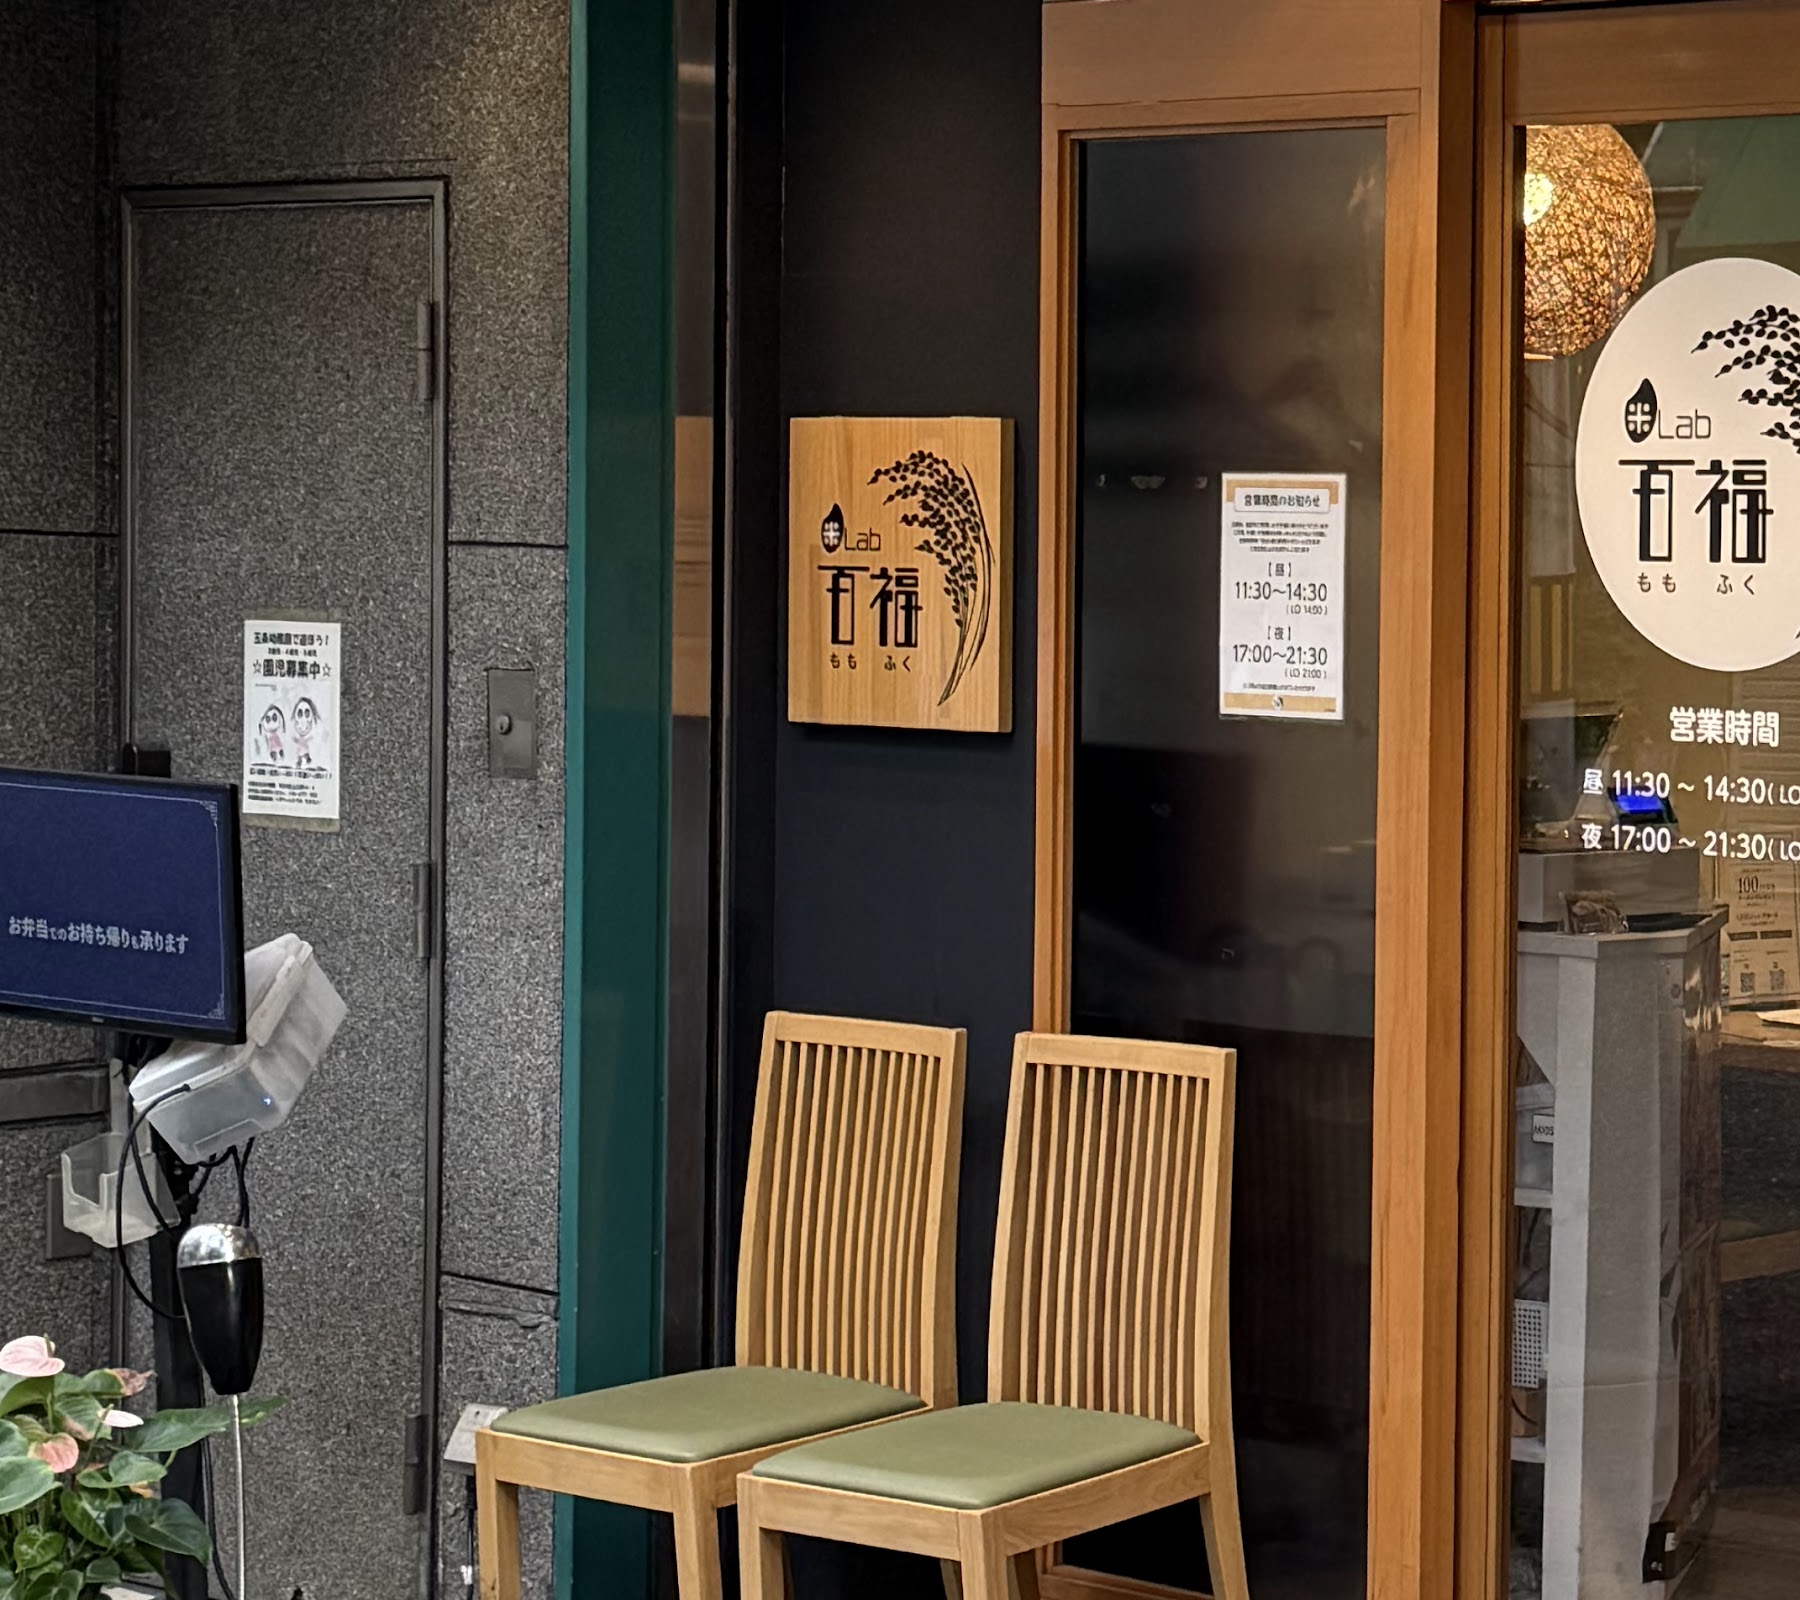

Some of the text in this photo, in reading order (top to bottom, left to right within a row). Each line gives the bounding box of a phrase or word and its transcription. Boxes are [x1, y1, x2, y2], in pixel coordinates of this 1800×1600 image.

[1244, 494, 1320, 508] 営業時間のお知らせ
[1618, 460, 1774, 563] 百福
[818, 565, 923, 648] 百福
[1669, 706, 1780, 747] 営業時間
[1583, 768, 1603, 795] 昼
[1612, 769, 1670, 799] 11:30
[1581, 823, 1603, 850] 夜
[1611, 824, 1671, 853] 17:00
